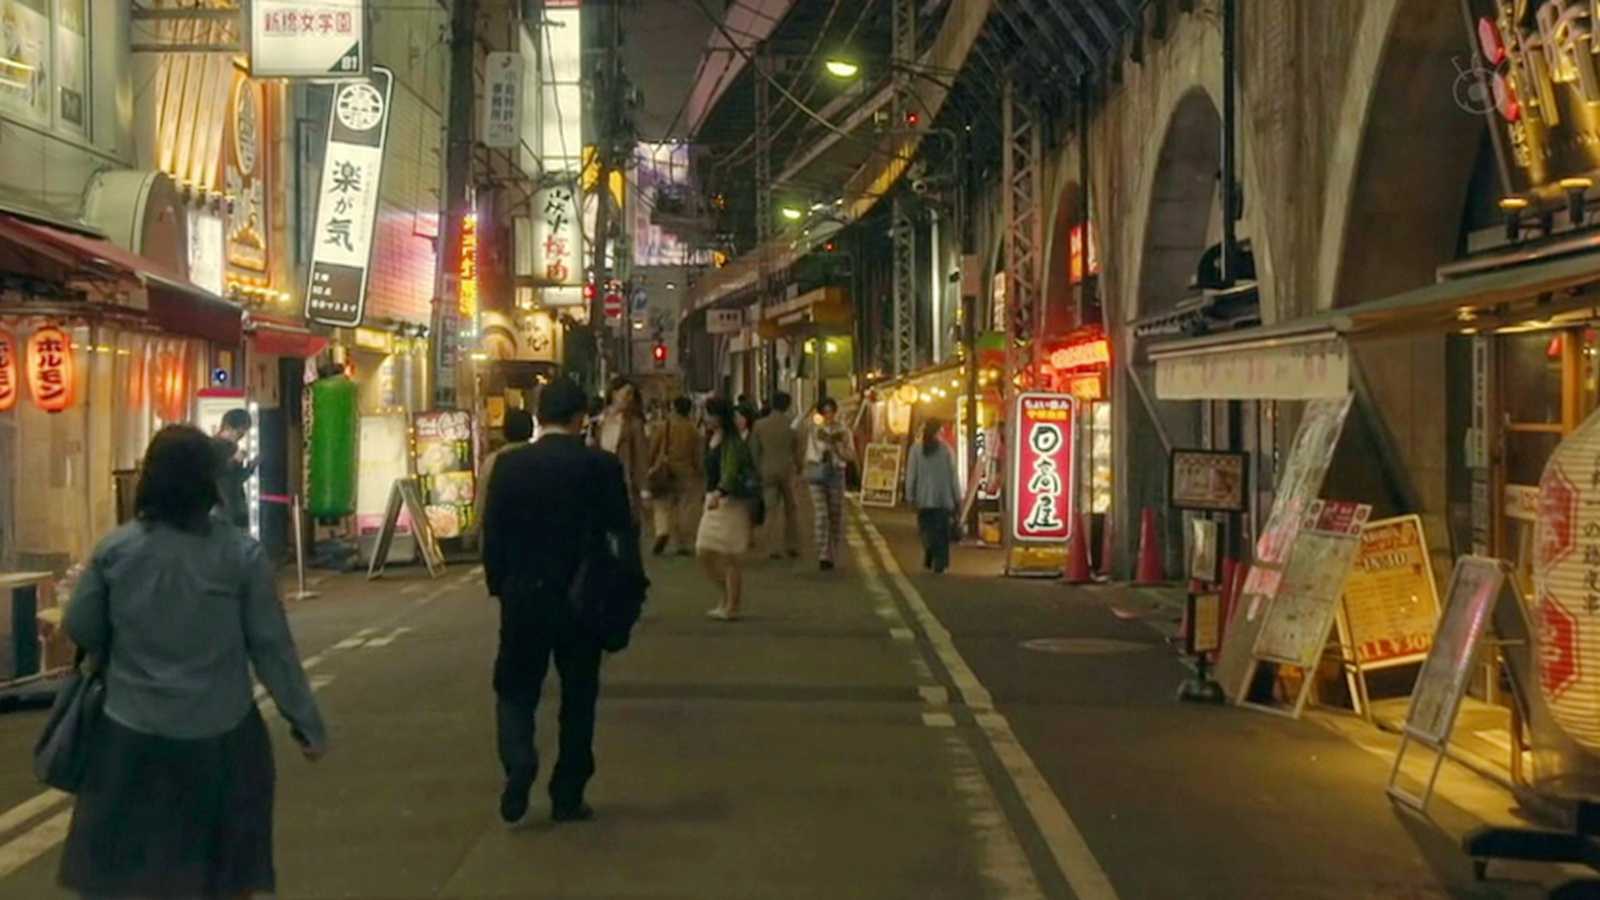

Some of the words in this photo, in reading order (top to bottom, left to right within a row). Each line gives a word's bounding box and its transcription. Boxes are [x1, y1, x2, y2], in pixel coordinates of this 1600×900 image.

[341, 55, 358, 71] B1
[324, 160, 362, 254] 楽が気
[541, 188, 571, 283] 炭火焼肉
[36, 337, 65, 401] ホルモン
[1026, 424, 1062, 530] 日高屋
